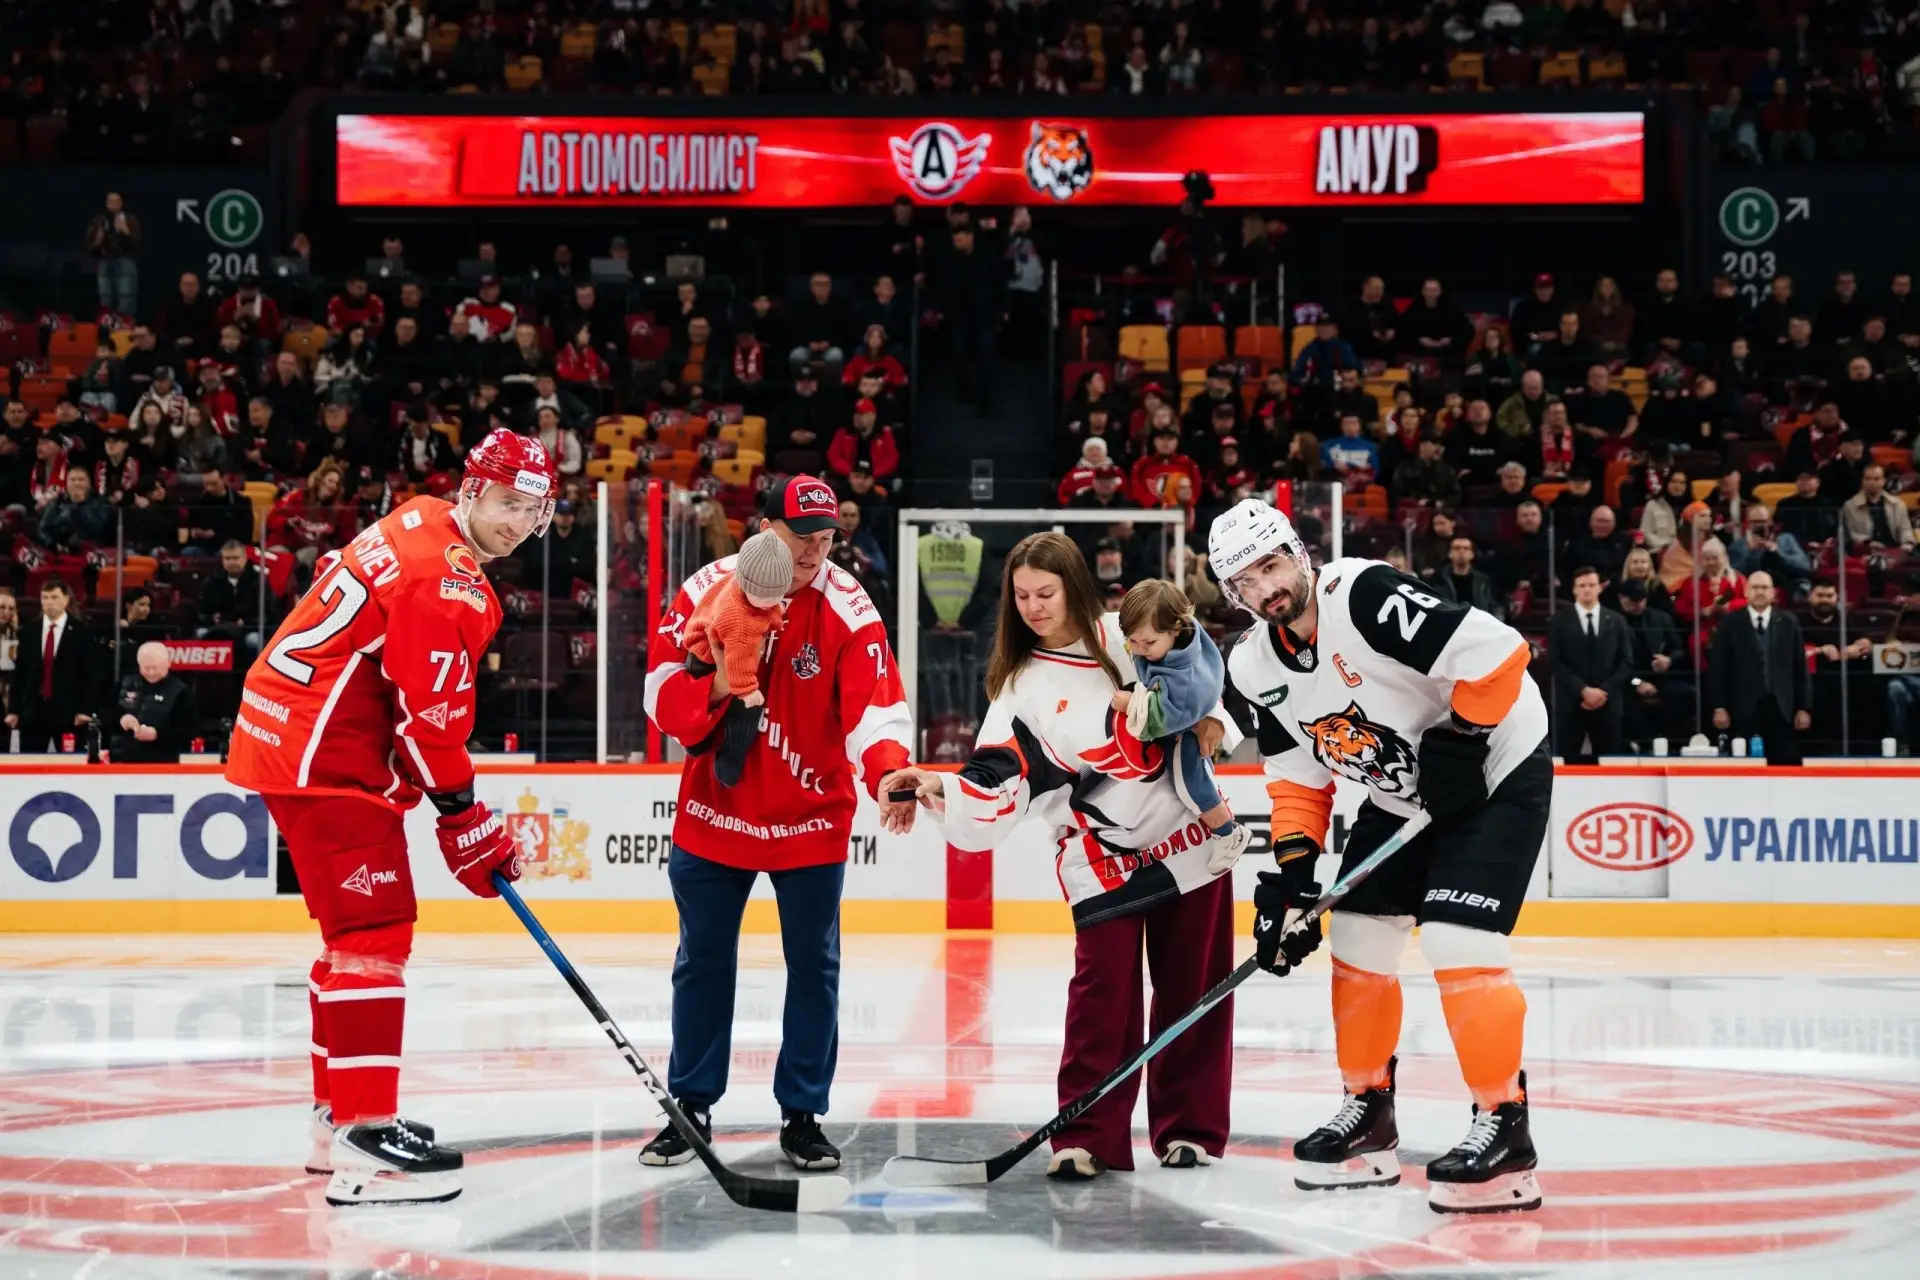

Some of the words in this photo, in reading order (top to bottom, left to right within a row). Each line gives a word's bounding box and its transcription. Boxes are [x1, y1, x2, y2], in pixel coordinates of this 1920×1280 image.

[517, 131, 760, 193] АВТОМОБИЛИСТ
[1315, 124, 1420, 194] АМУР
[207, 252, 259, 281] 204
[1722, 250, 1776, 279] 203
[1376, 583, 1442, 643] 26
[168, 646, 232, 664] ONBET
[430, 649, 472, 692] 72
[1332, 652, 1363, 688] C
[653, 800, 677, 818] ПР
[606, 834, 672, 870] СВЕРД
[851, 835, 876, 865] ТИ
[1578, 812, 1683, 862] УЗТМ
[1704, 817, 1919, 863] УРАЛМАШ
[371, 870, 398, 885] РМК
